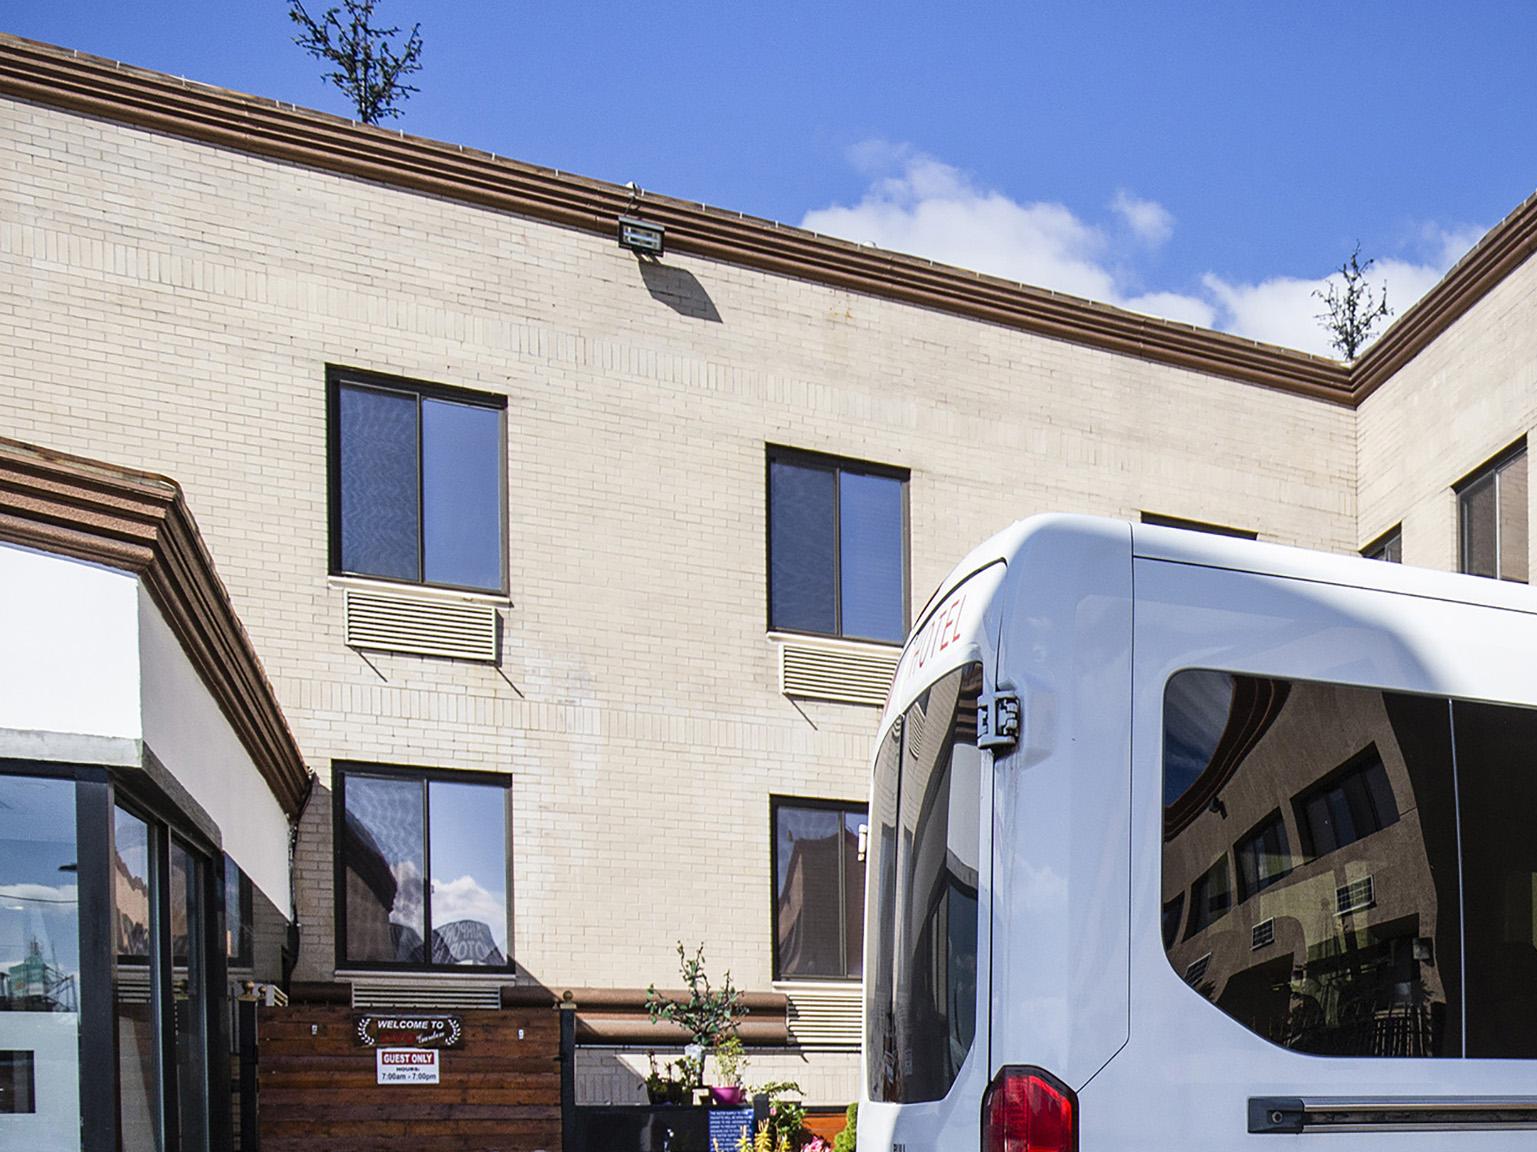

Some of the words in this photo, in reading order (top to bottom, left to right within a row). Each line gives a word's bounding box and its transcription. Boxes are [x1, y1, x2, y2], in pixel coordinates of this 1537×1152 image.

[377, 1020, 428, 1029] WELCOME
[431, 1020, 445, 1029] TO
[383, 1053, 410, 1064] GUEST
[411, 1053, 433, 1064] ONLY
